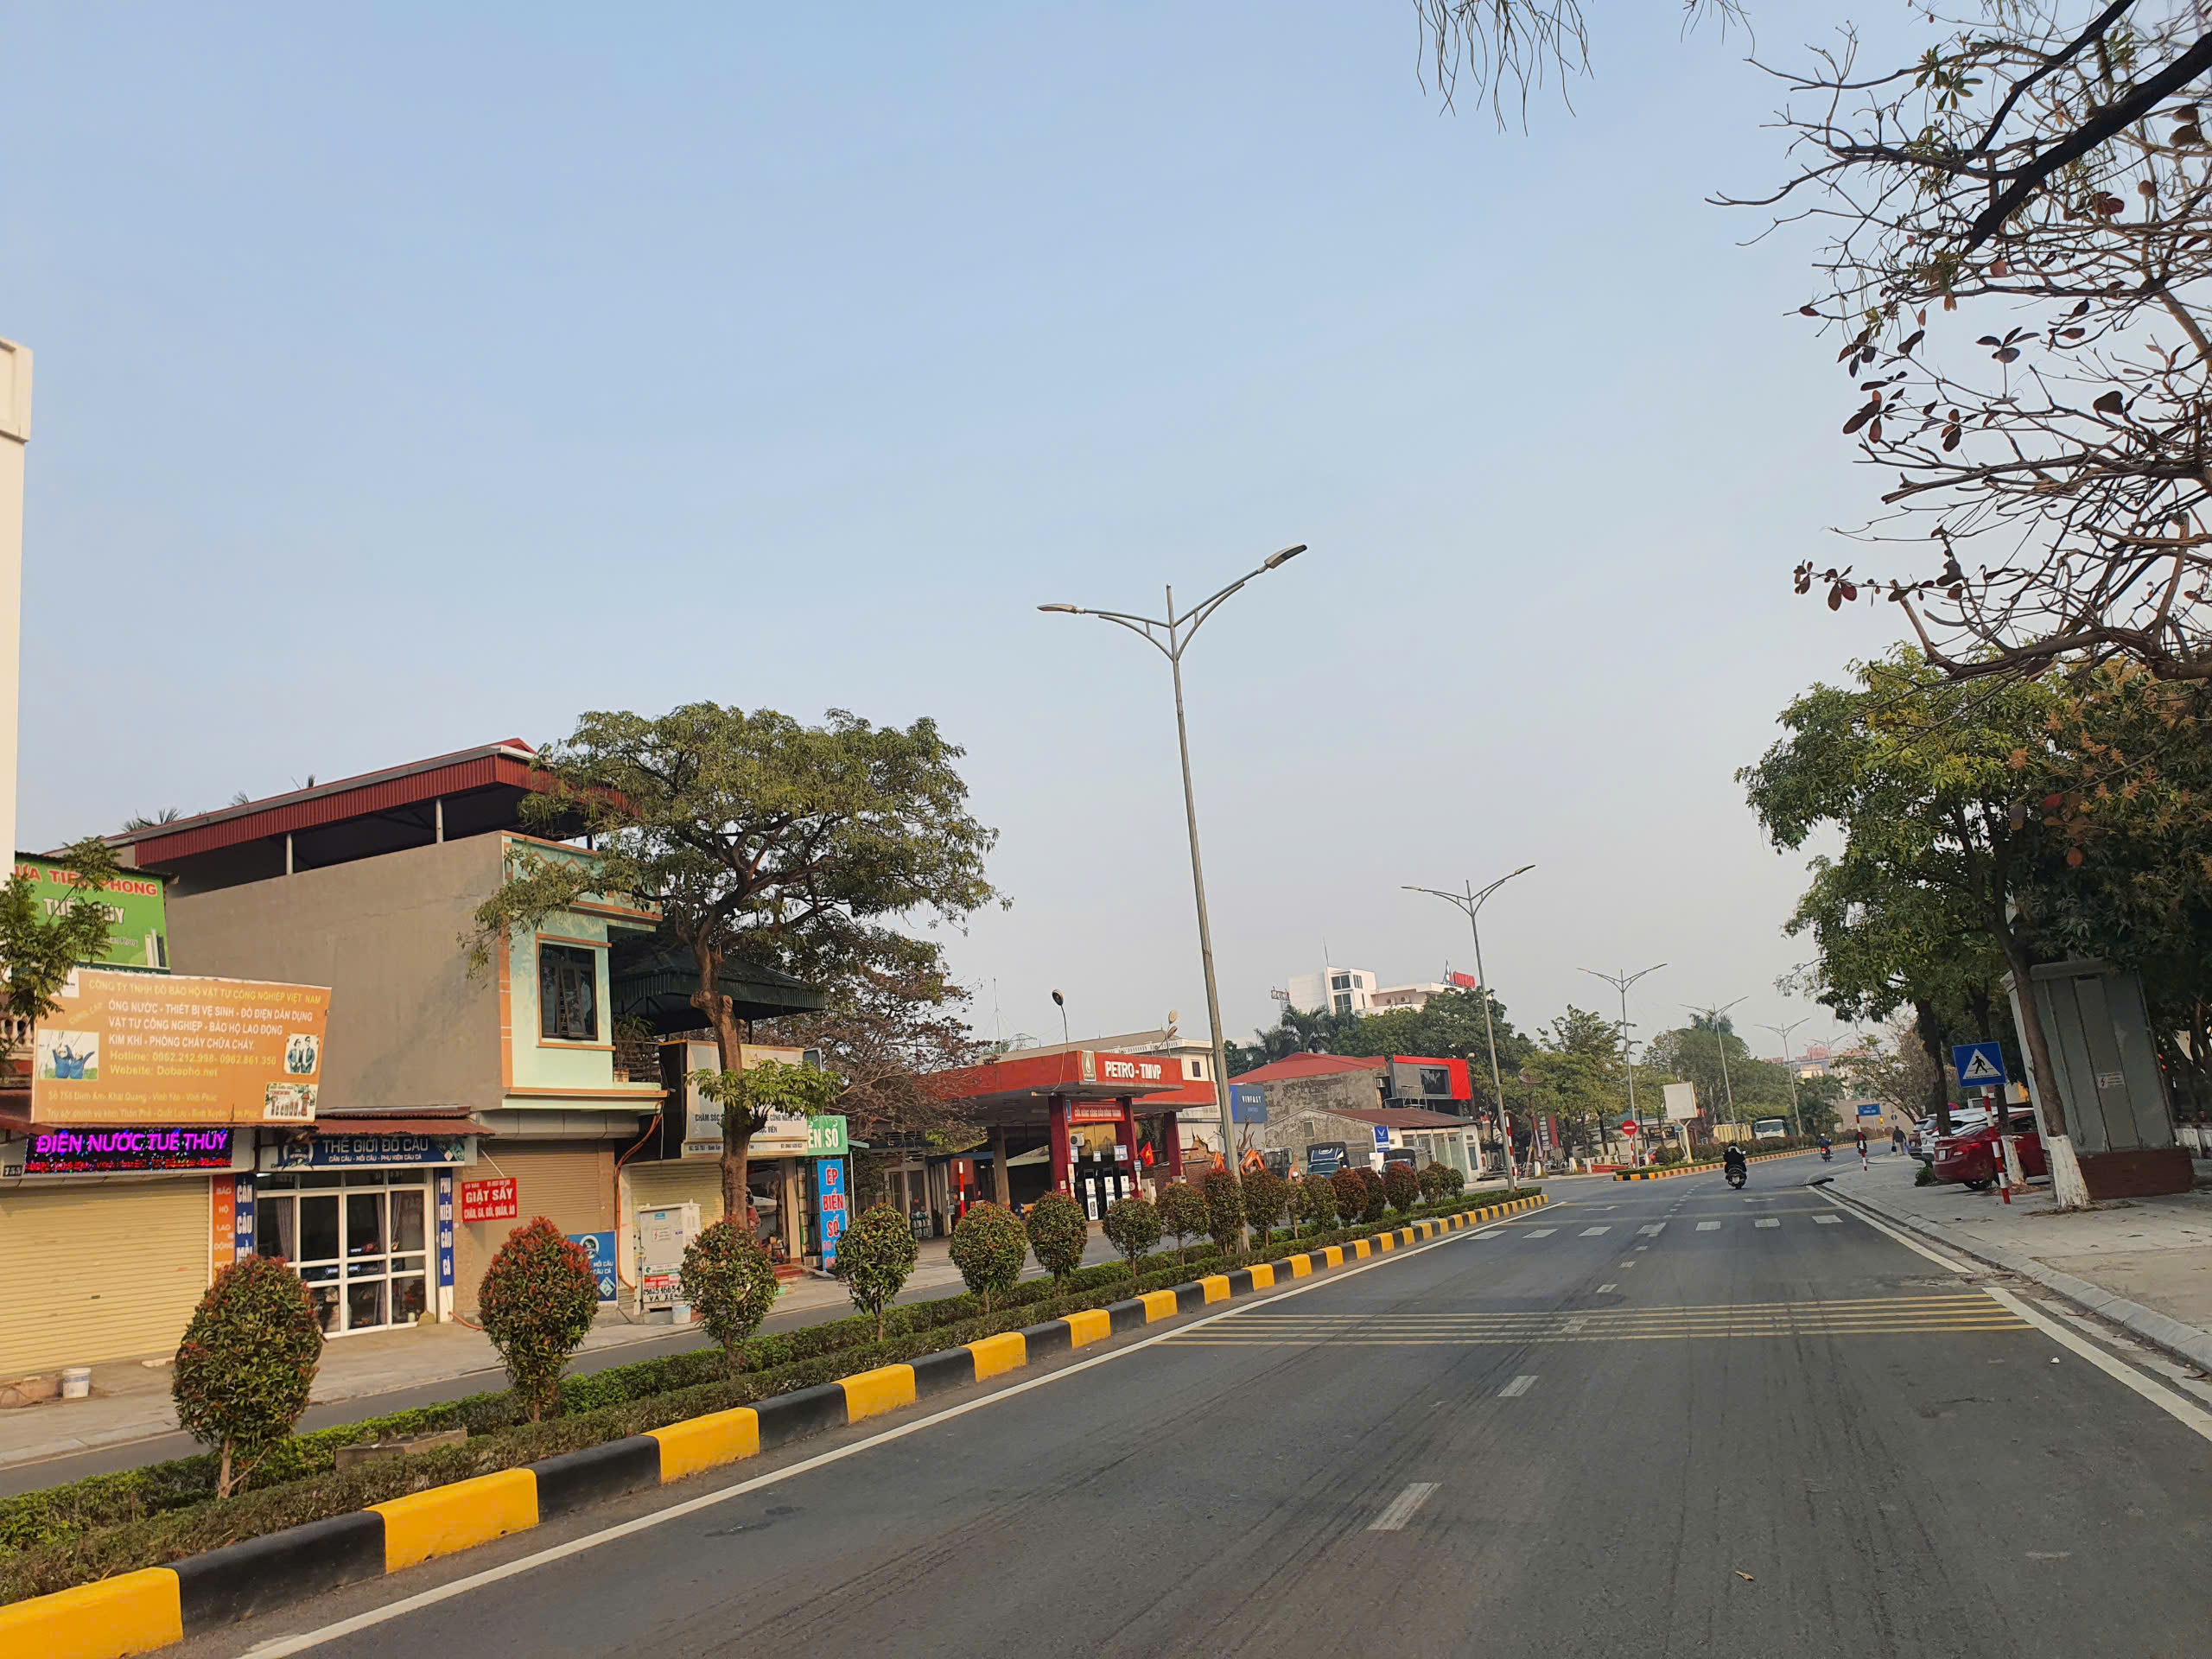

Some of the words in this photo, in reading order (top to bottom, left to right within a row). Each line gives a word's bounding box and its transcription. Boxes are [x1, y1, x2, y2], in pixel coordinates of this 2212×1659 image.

[89, 979, 115, 991] CÔNG
[118, 982, 128, 992] TY
[130, 982, 152, 994] TNHH
[233, 988, 256, 1000] CÔNG
[305, 995, 321, 1004] NAM
[131, 1001, 158, 1014] NƯỚC
[166, 1002, 189, 1014] THIẾT
[192, 1004, 200, 1017] BỊ
[214, 1007, 234, 1017] SINH
[254, 1008, 272, 1021] ĐIỆN
[291, 1010, 313, 1023] DỤNG
[143, 1017, 168, 1030] CÔNG
[171, 1020, 203, 1033] NGHIỆP
[243, 1025, 258, 1034] LAO
[260, 1025, 283, 1037] ĐỘNG
[109, 1034, 125, 1045] KIM
[127, 1032, 143, 1045] KHÍ
[149, 1033, 180, 1046] PHÒNG
[181, 1035, 205, 1048] CHÁY
[710, 1113, 721, 1122] SÓC
[440, 1177, 451, 1197] PHỤ
[466, 1188, 489, 1205] GIẶT
[440, 1201, 452, 1224] KIỆN
[441, 1228, 452, 1249] CÂU
[442, 1255, 451, 1276] CÁ
